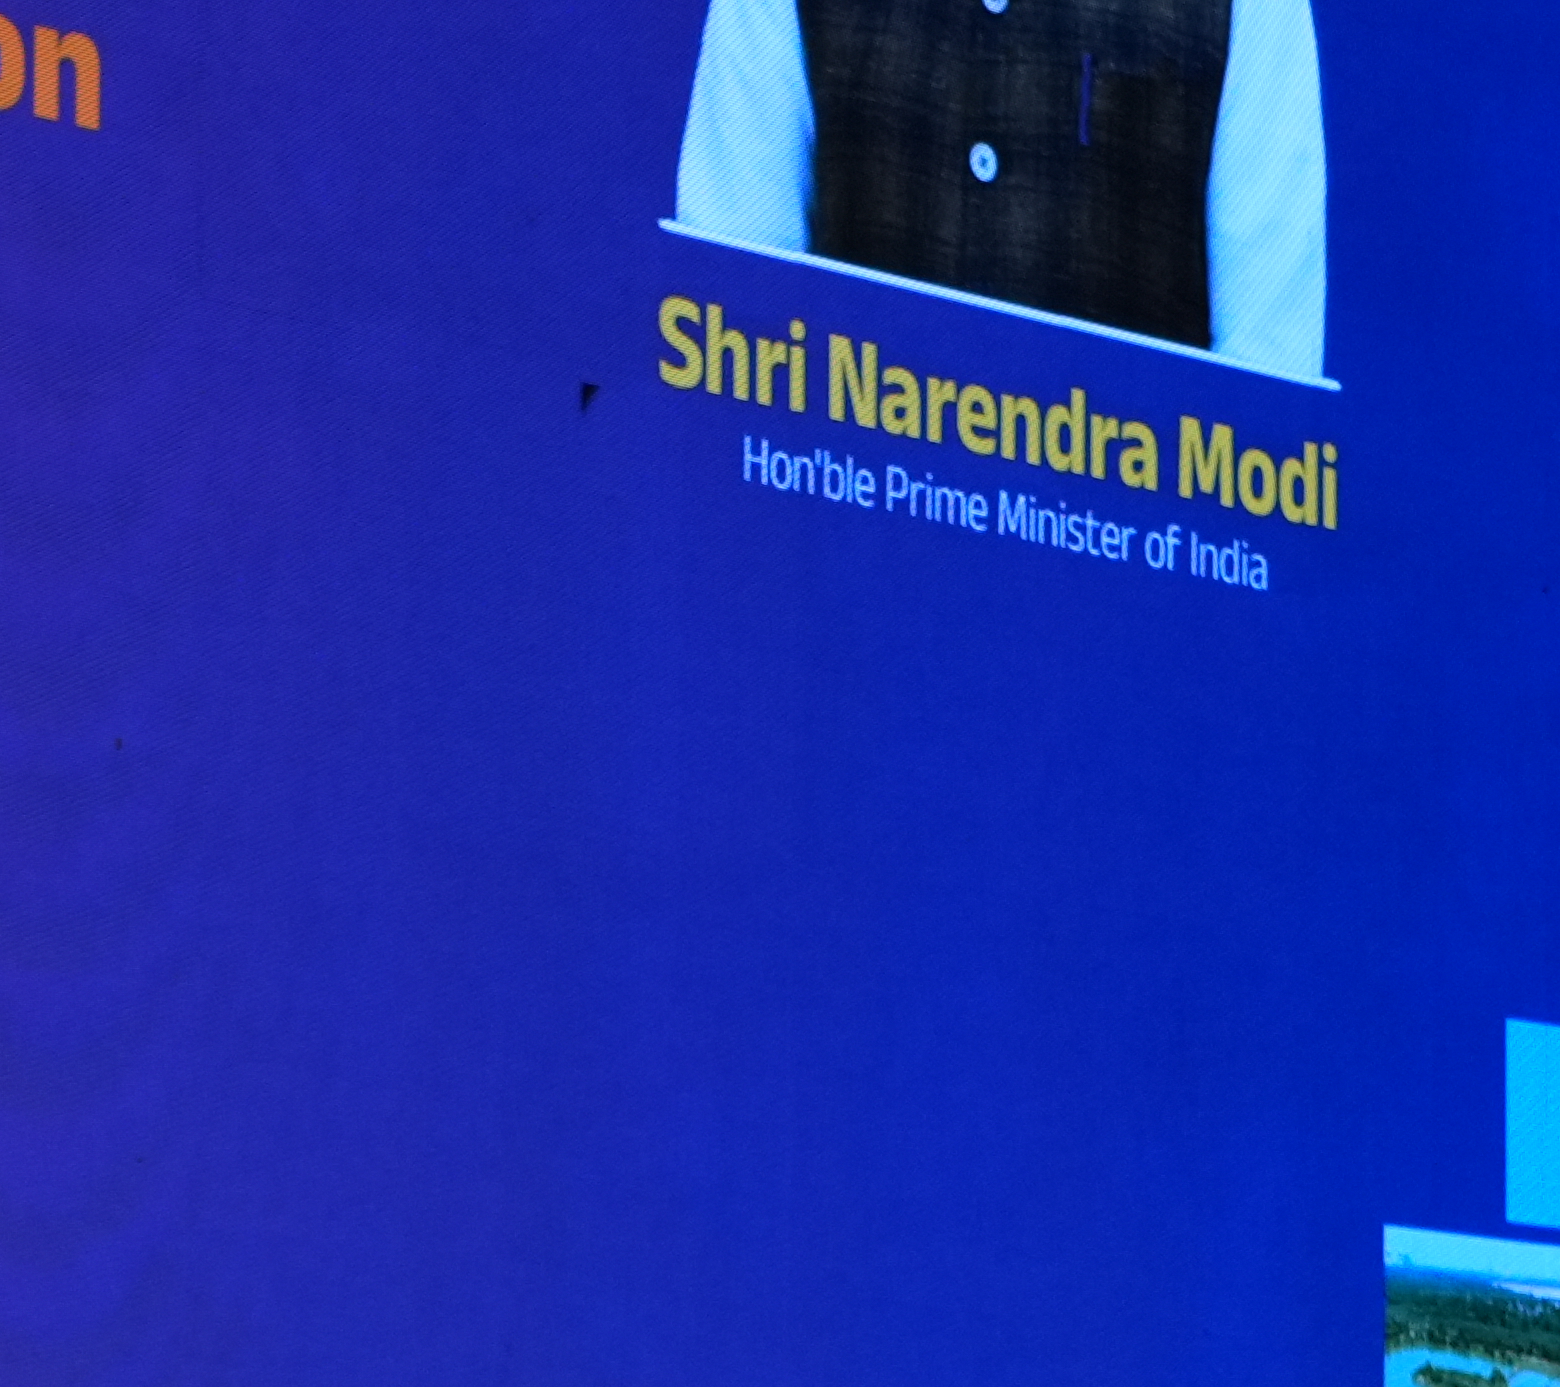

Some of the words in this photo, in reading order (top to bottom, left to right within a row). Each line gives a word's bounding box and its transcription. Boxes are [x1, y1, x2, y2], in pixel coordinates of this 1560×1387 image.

[658, 295, 806, 413] Shri
[828, 333, 1158, 492] Narendra
[1178, 415, 1338, 530] Modi
[743, 435, 875, 508] Hon'ble
[886, 464, 988, 533] Prime
[998, 490, 1137, 562] Minister
[1144, 524, 1181, 572] of
[1190, 531, 1269, 591] India
